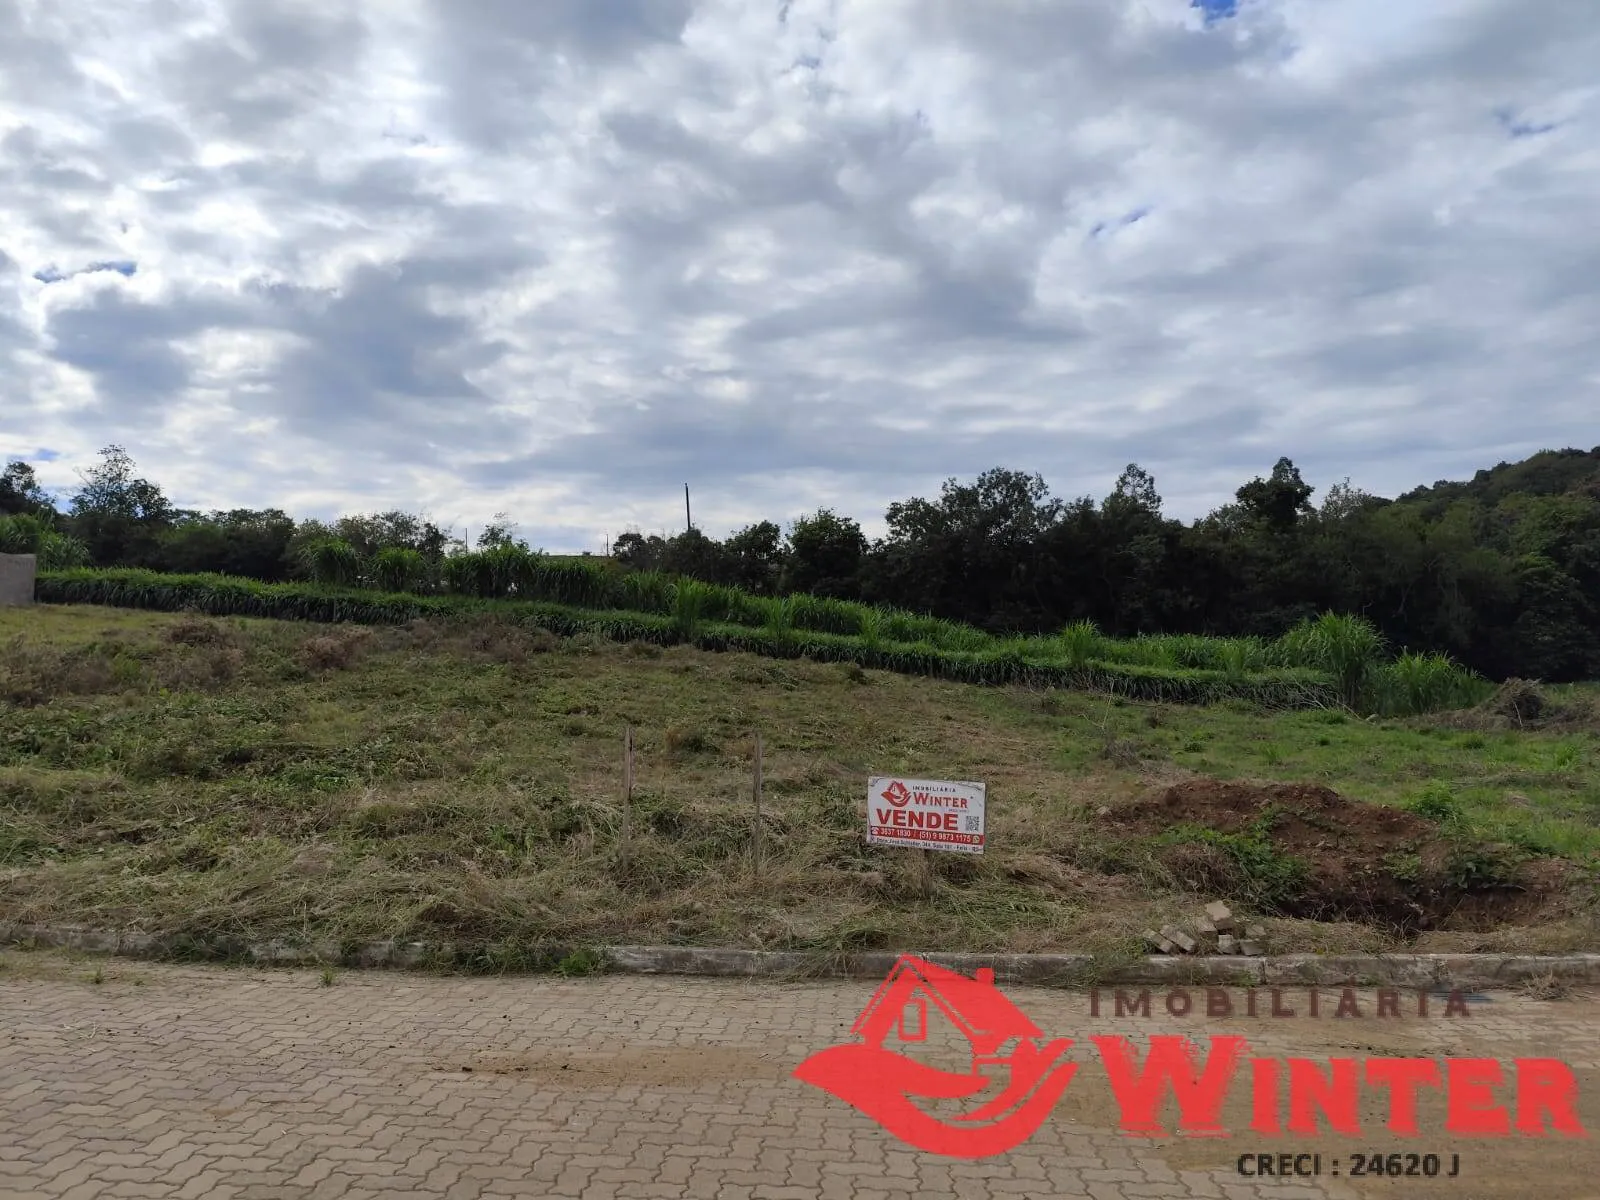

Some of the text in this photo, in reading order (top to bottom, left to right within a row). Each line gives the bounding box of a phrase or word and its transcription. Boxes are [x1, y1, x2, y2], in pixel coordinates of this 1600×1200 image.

[913, 792, 968, 808] WINTER
[876, 809, 959, 831] VENDE
[919, 831, 932, 840] (51)
